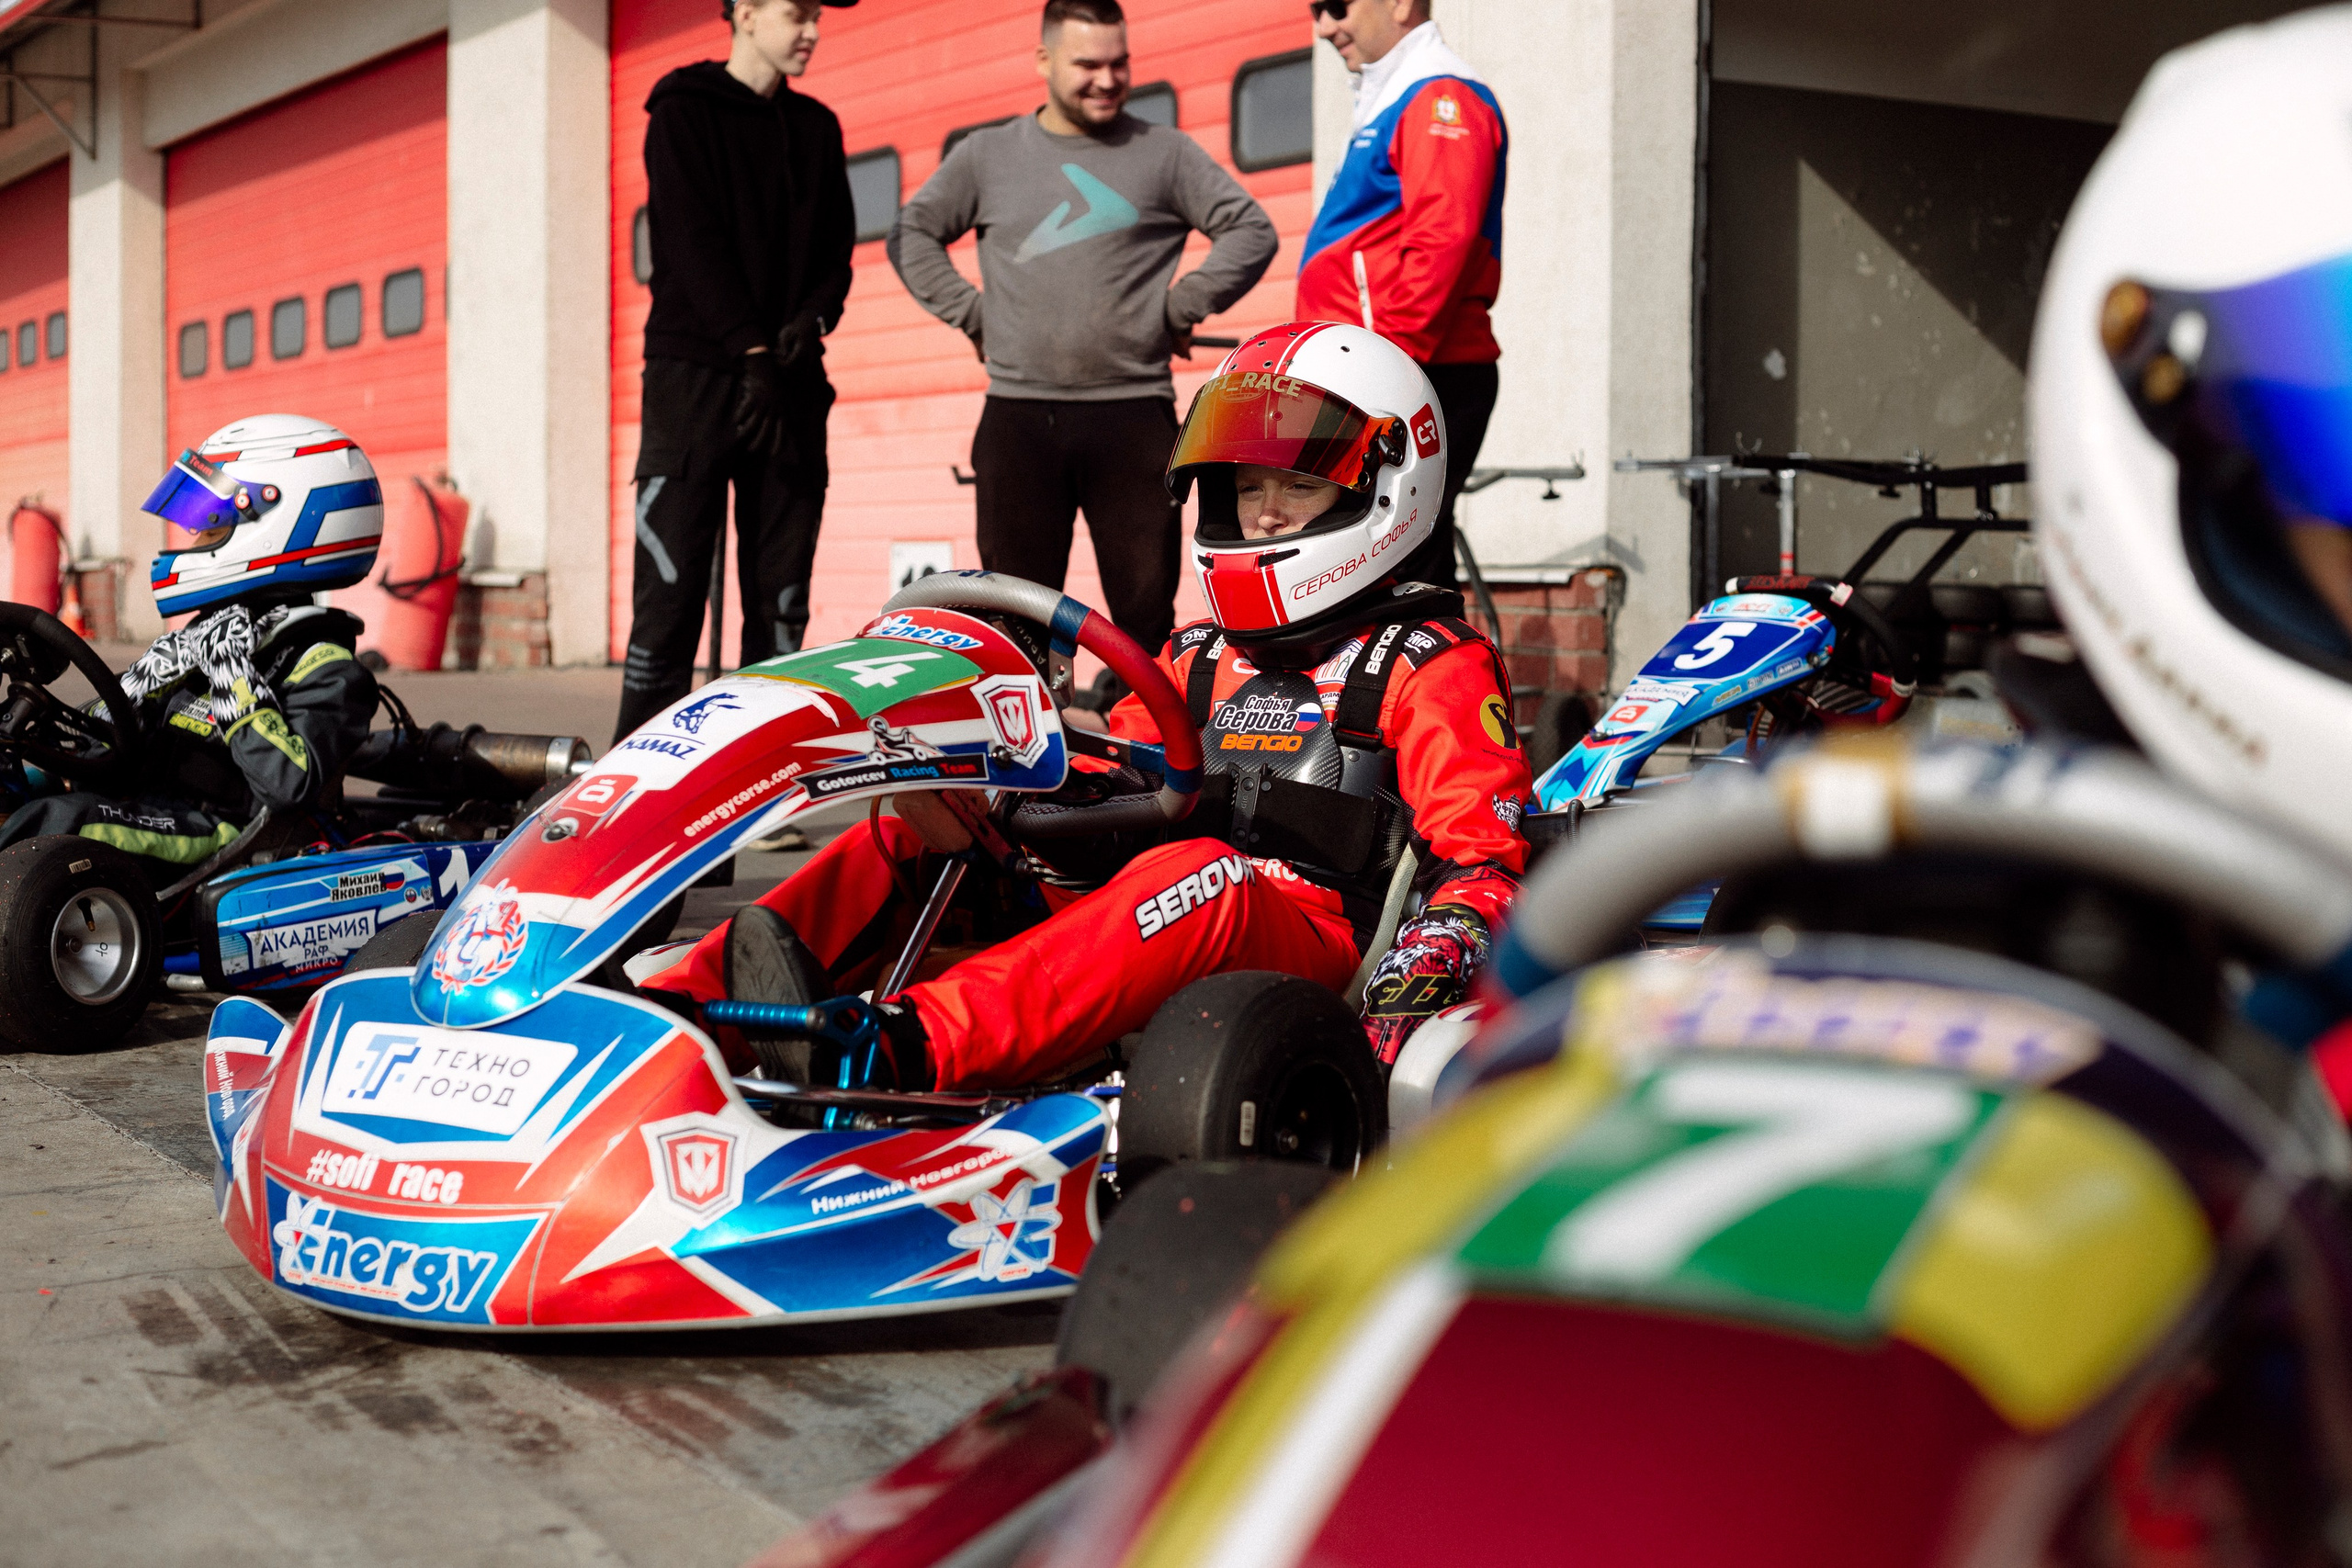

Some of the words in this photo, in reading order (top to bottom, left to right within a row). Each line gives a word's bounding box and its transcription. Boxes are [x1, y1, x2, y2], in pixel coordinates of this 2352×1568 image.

[1294, 552, 1367, 600] СЕРОВА
[1372, 508, 1418, 558] СОФЬЯ
[867, 615, 984, 650] Energy
[1674, 622, 1757, 670] 5
[1365, 625, 1403, 675] BENGIO
[1244, 695, 1293, 712] Софья
[1216, 705, 1299, 733] Серова
[619, 739, 697, 761] KAMAZ
[1220, 734, 1303, 751] BENGIO
[817, 771, 887, 792] Gotovcev
[889, 765, 941, 779] Racing
[940, 763, 978, 775] Team
[684, 761, 802, 837] energycorse.com
[98, 804, 175, 830] THUNDER
[331, 883, 389, 903] Яковлев
[339, 872, 386, 888] Михаил
[260, 917, 369, 956] АКАДЕМИЯ
[304, 944, 329, 958] РАФ
[294, 955, 339, 974] МИКРО
[434, 1049, 530, 1077] ТЕХНО
[413, 1076, 514, 1107] ГОРОД
[388, 1163, 465, 1205] race
[1542, 1059, 1981, 1280] 7
[811, 1179, 906, 1215] Нижний
[277, 1200, 498, 1314] Energy
